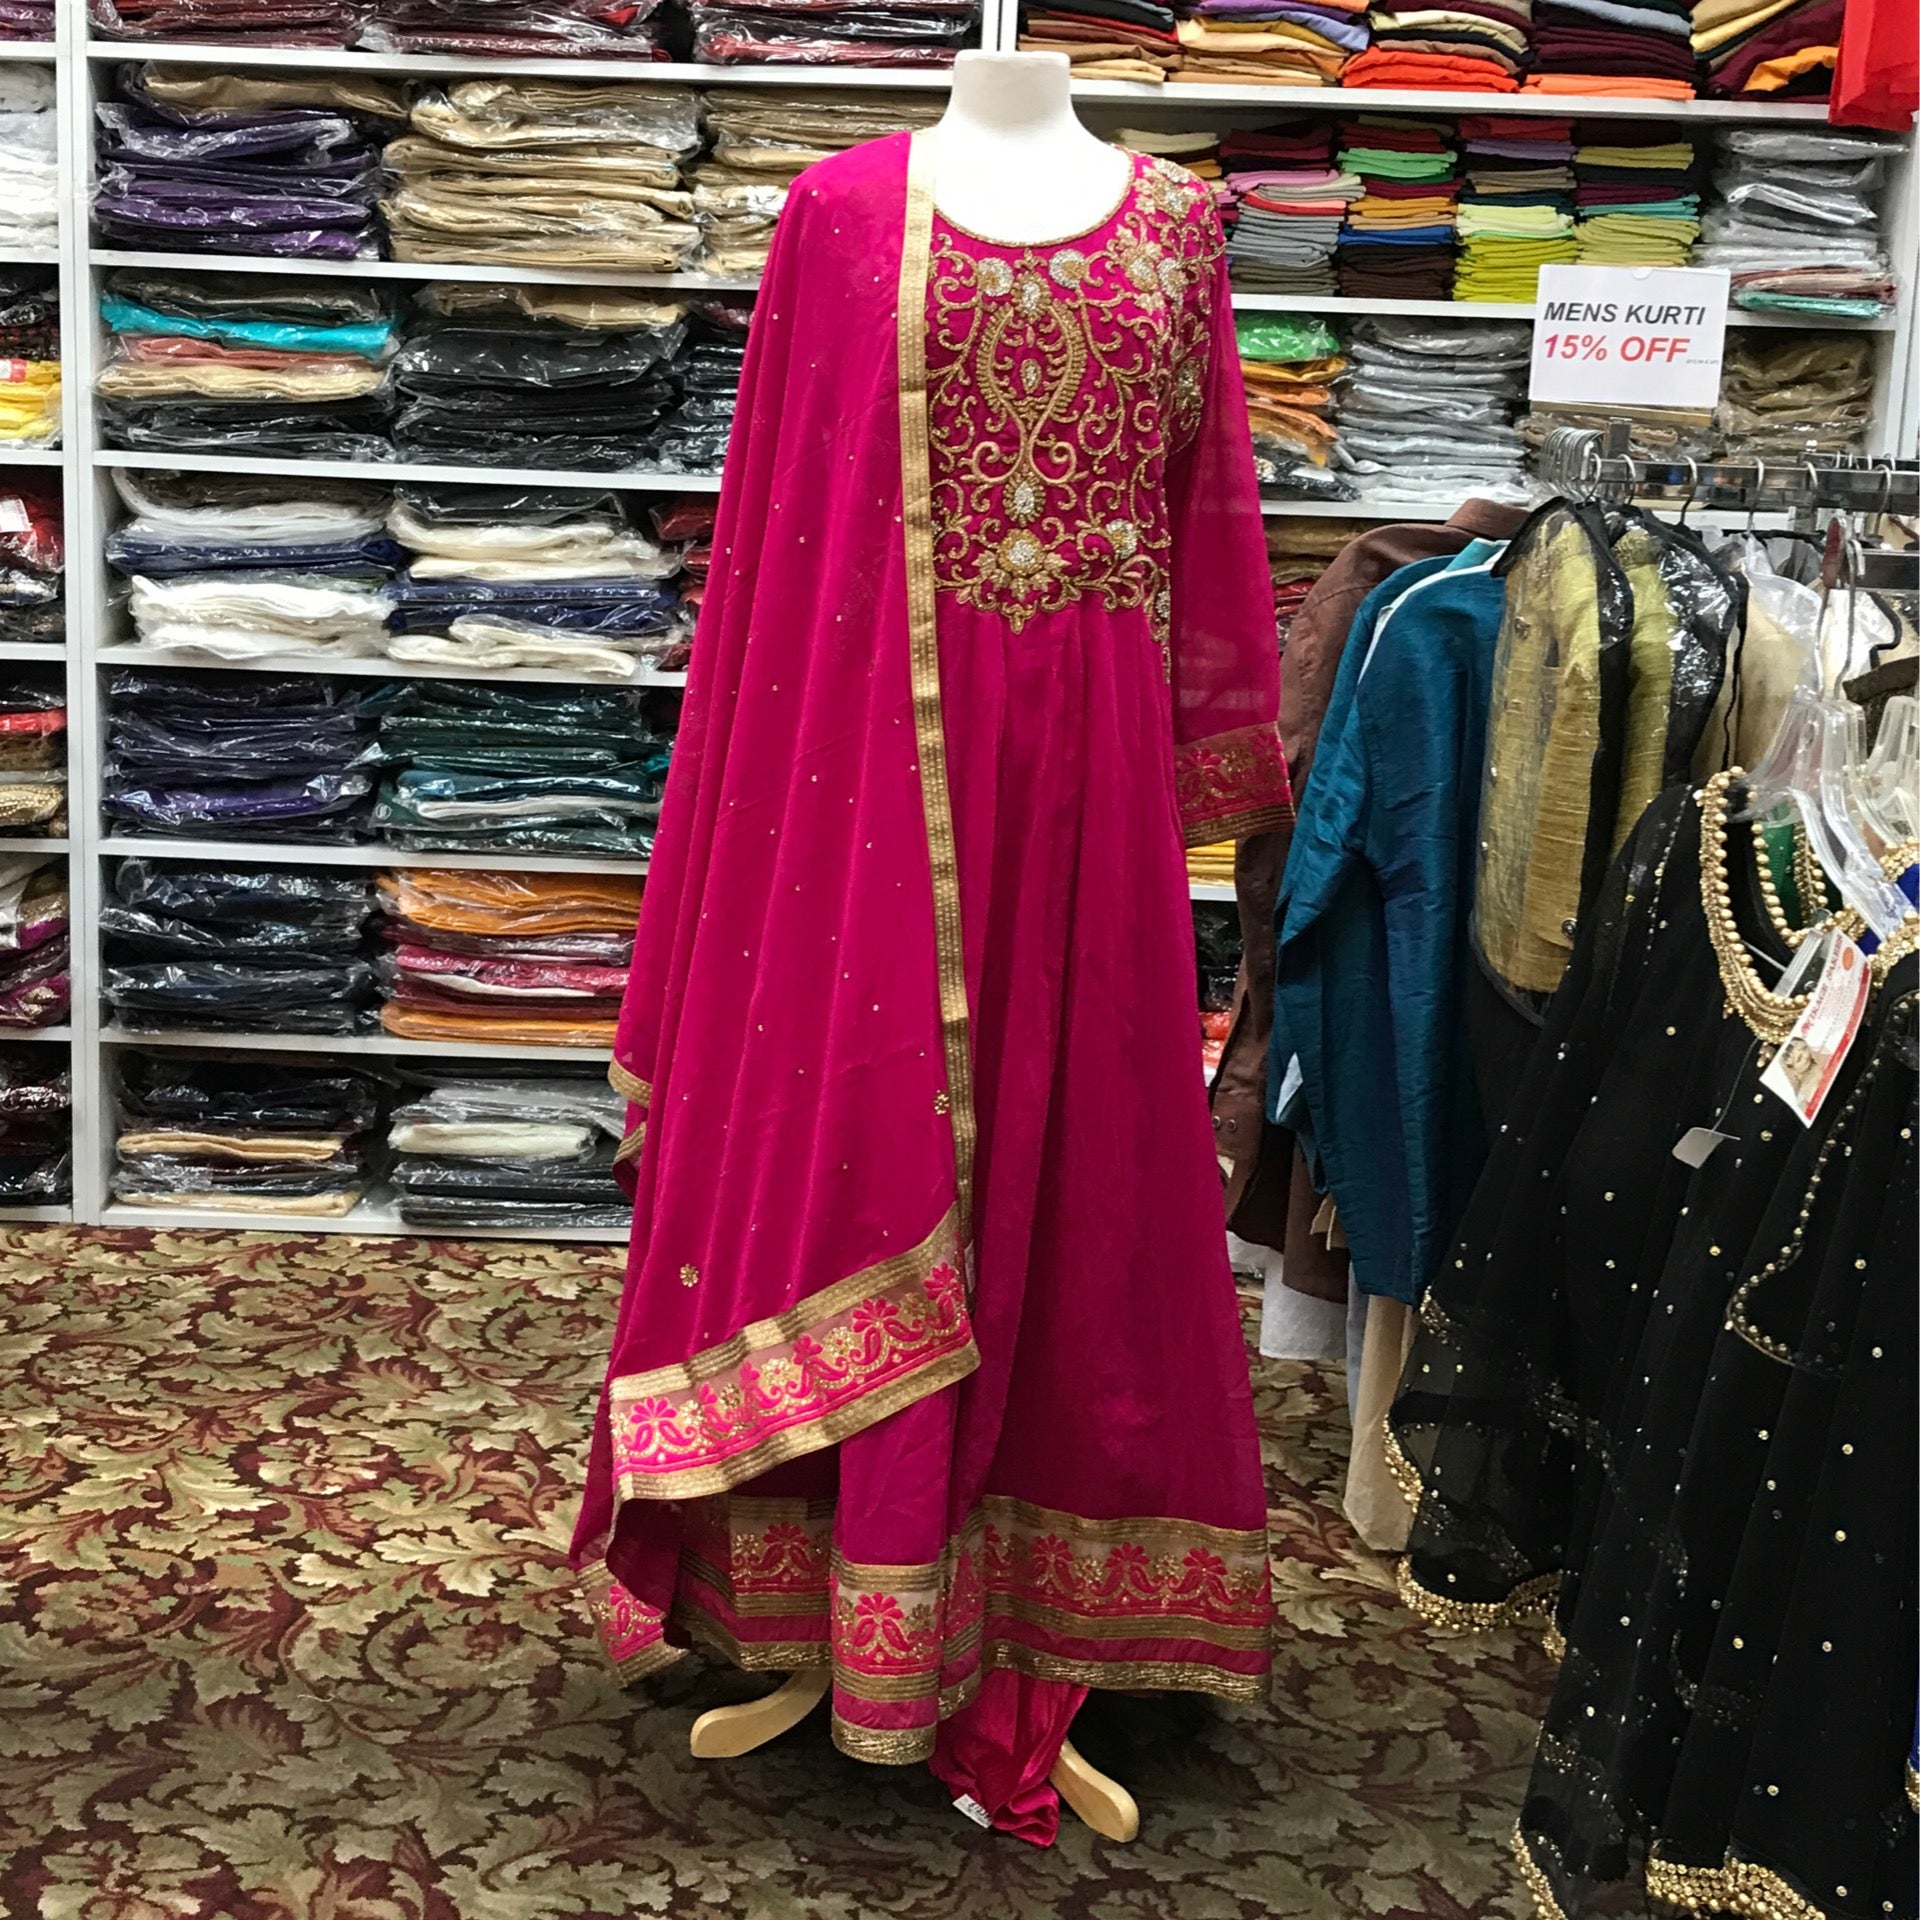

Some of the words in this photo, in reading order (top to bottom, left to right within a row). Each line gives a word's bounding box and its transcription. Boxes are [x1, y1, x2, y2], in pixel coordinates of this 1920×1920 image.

[1544, 302, 1618, 322] MENS
[1624, 304, 1706, 325] KURTI
[1544, 334, 1607, 361] 15%
[1620, 336, 1690, 362] OFF
